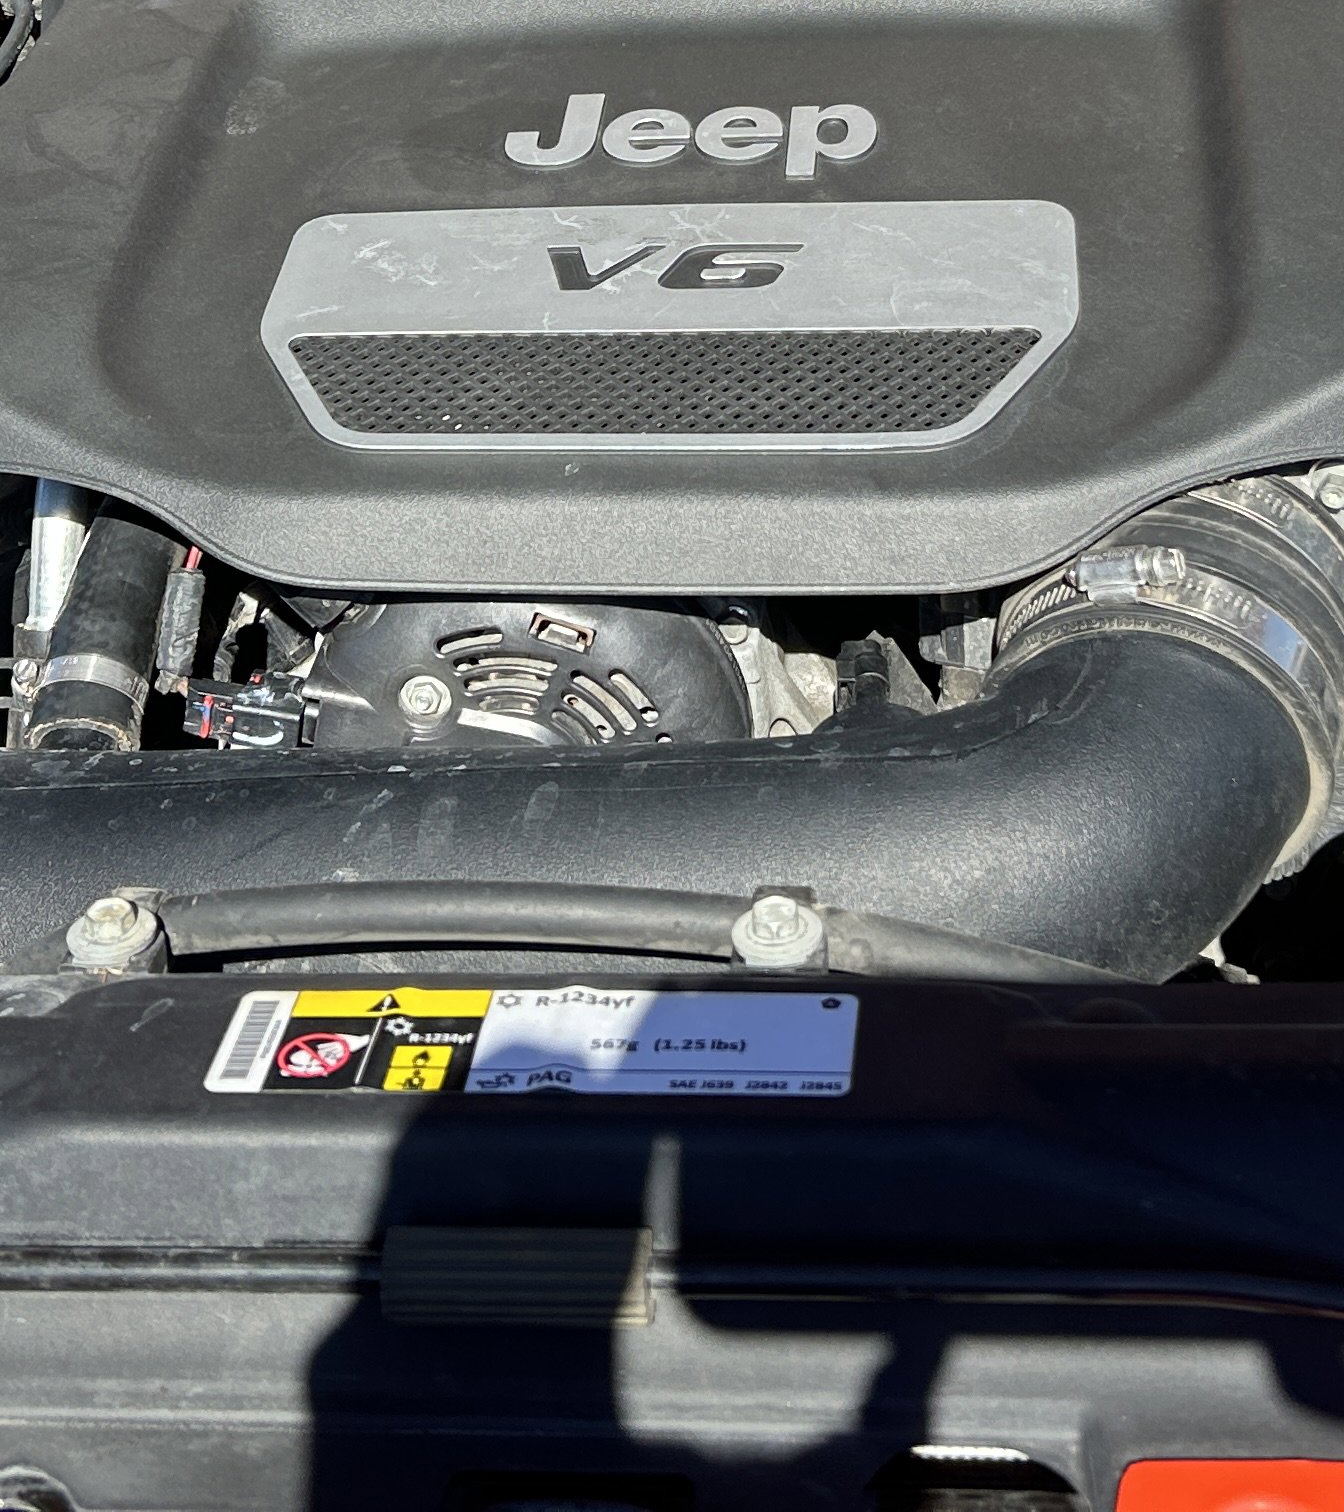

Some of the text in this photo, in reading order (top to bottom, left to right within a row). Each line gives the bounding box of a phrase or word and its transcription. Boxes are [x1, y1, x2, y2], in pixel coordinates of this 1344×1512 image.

[503, 92, 880, 181] Jeep
[546, 242, 806, 292] V6
[535, 990, 636, 1010] R-1234yf
[408, 1032, 475, 1045] R-1234yf
[590, 1037, 747, 1053] 567g (1.25 lbs)
[526, 1069, 572, 1085] PAG
[669, 1079, 697, 1089] SAE
